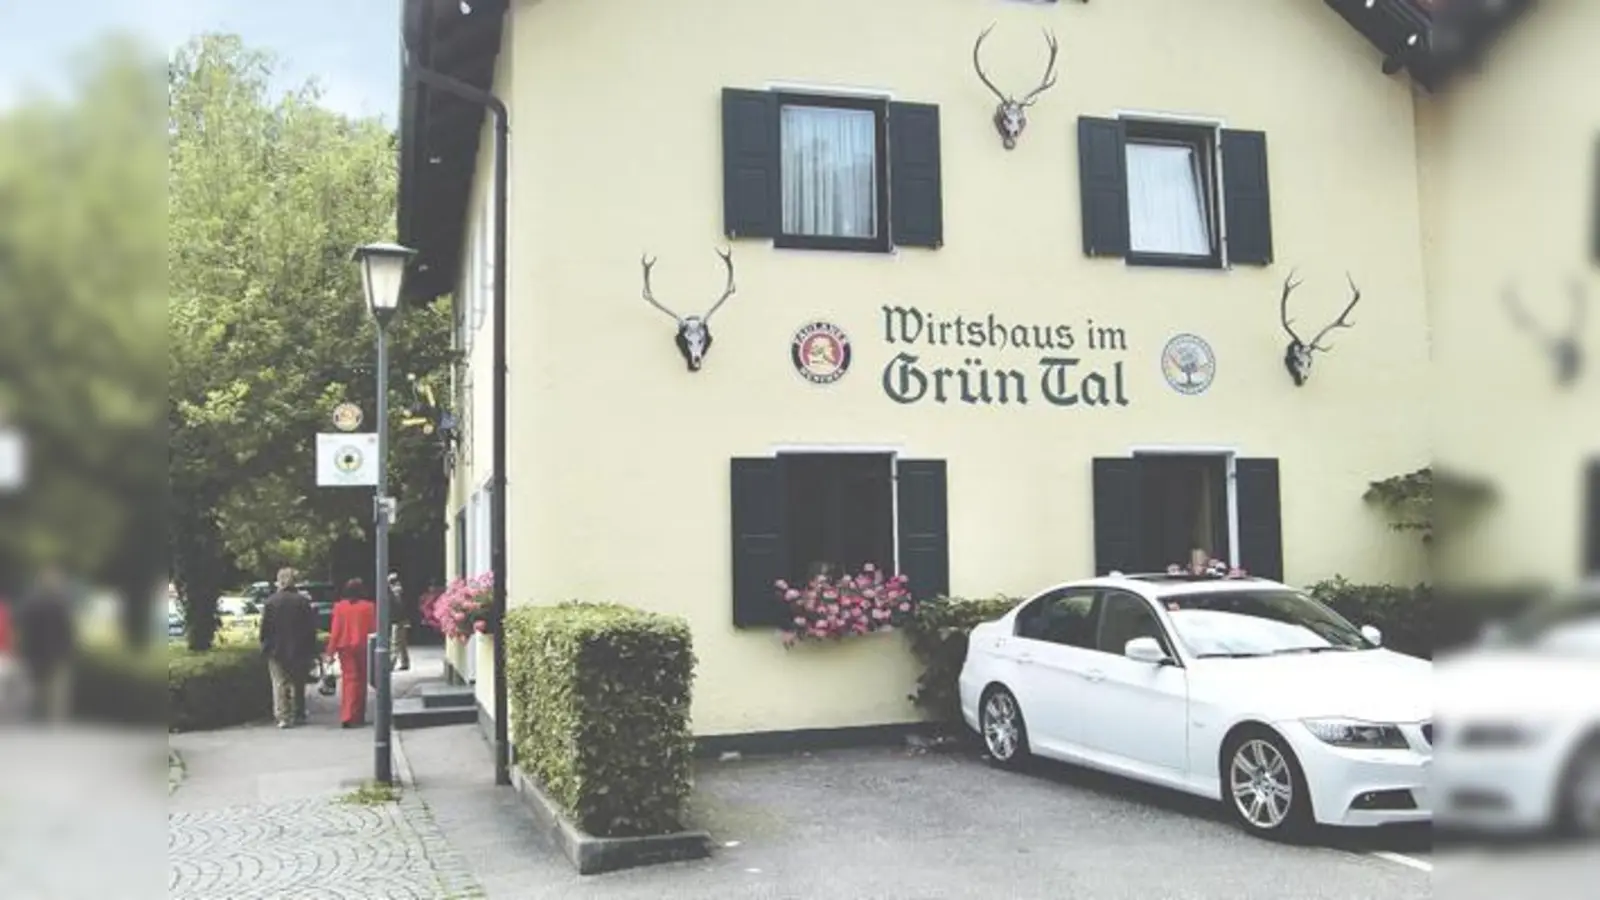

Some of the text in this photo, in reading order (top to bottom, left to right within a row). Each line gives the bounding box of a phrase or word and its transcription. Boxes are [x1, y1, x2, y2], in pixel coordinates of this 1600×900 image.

[881, 304, 1127, 351] Wirtshaus im
[882, 351, 1028, 404] Grün
[1038, 356, 1129, 406] Tal
